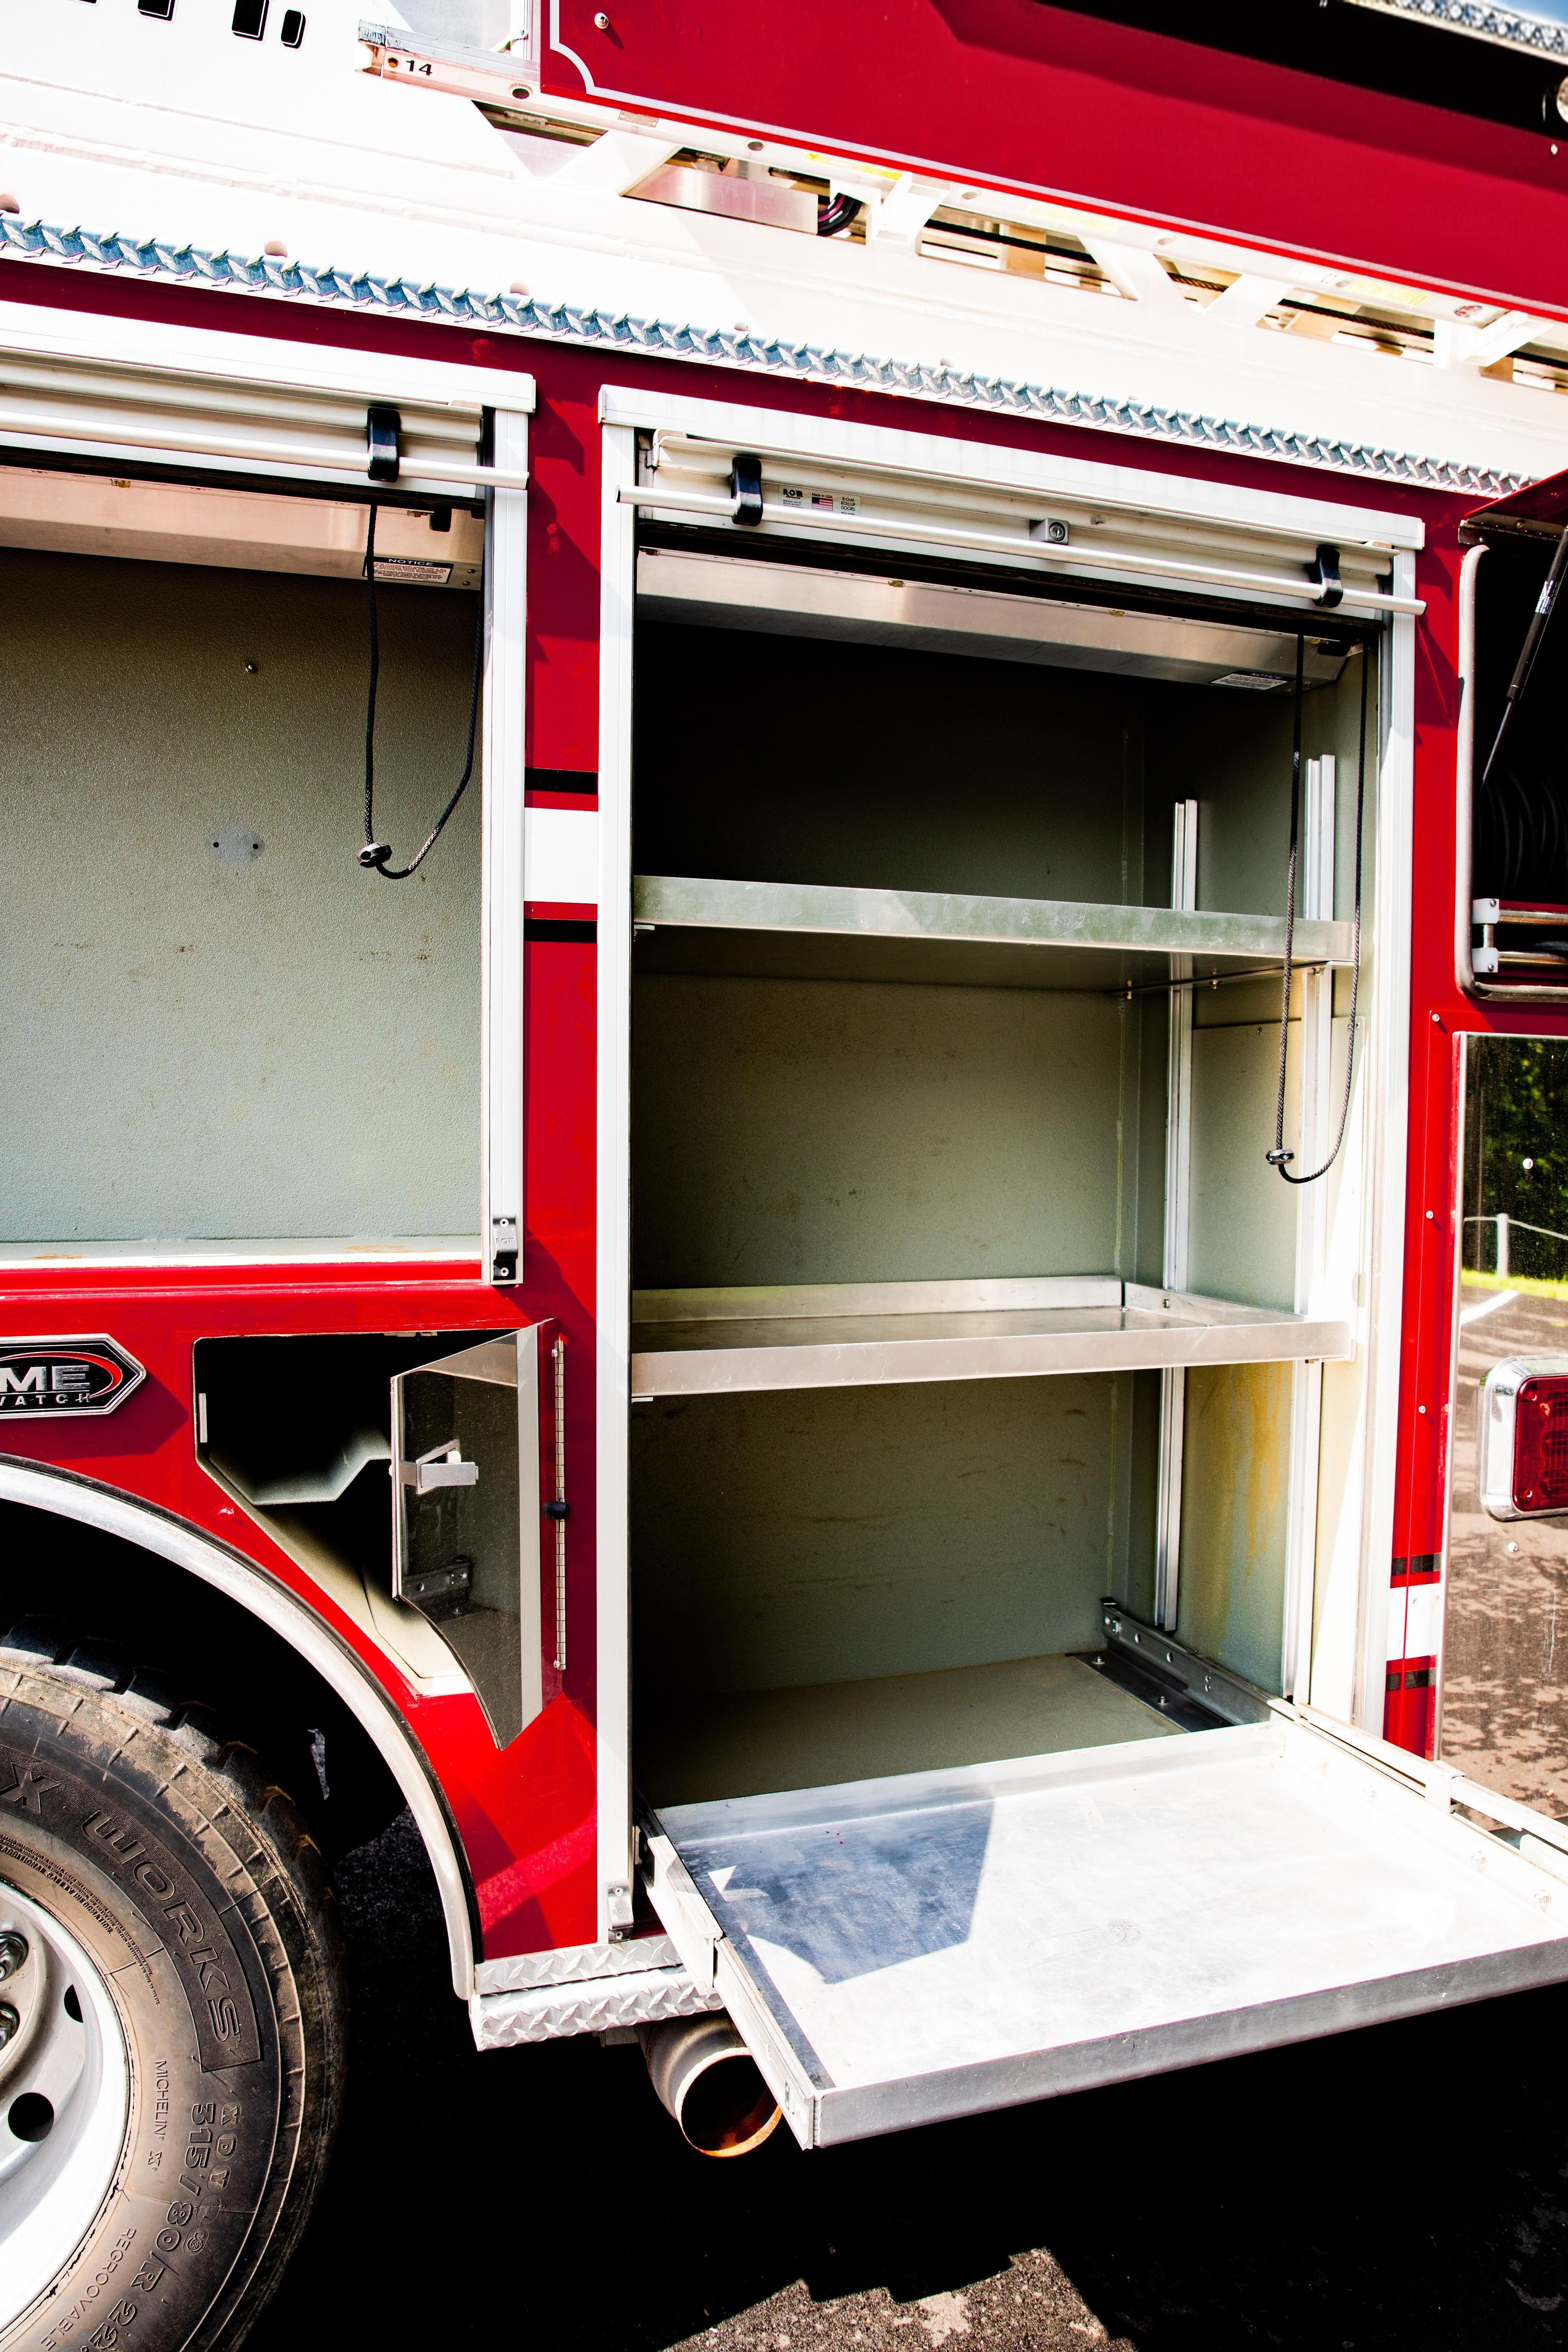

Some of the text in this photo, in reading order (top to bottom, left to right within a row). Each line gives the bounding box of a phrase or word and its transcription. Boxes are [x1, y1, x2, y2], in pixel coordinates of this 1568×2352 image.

[406, 60, 433, 76] 14
[0, 1762, 240, 2042] X WORKS
[40, 2226, 137, 2351] REGROOVABLE
